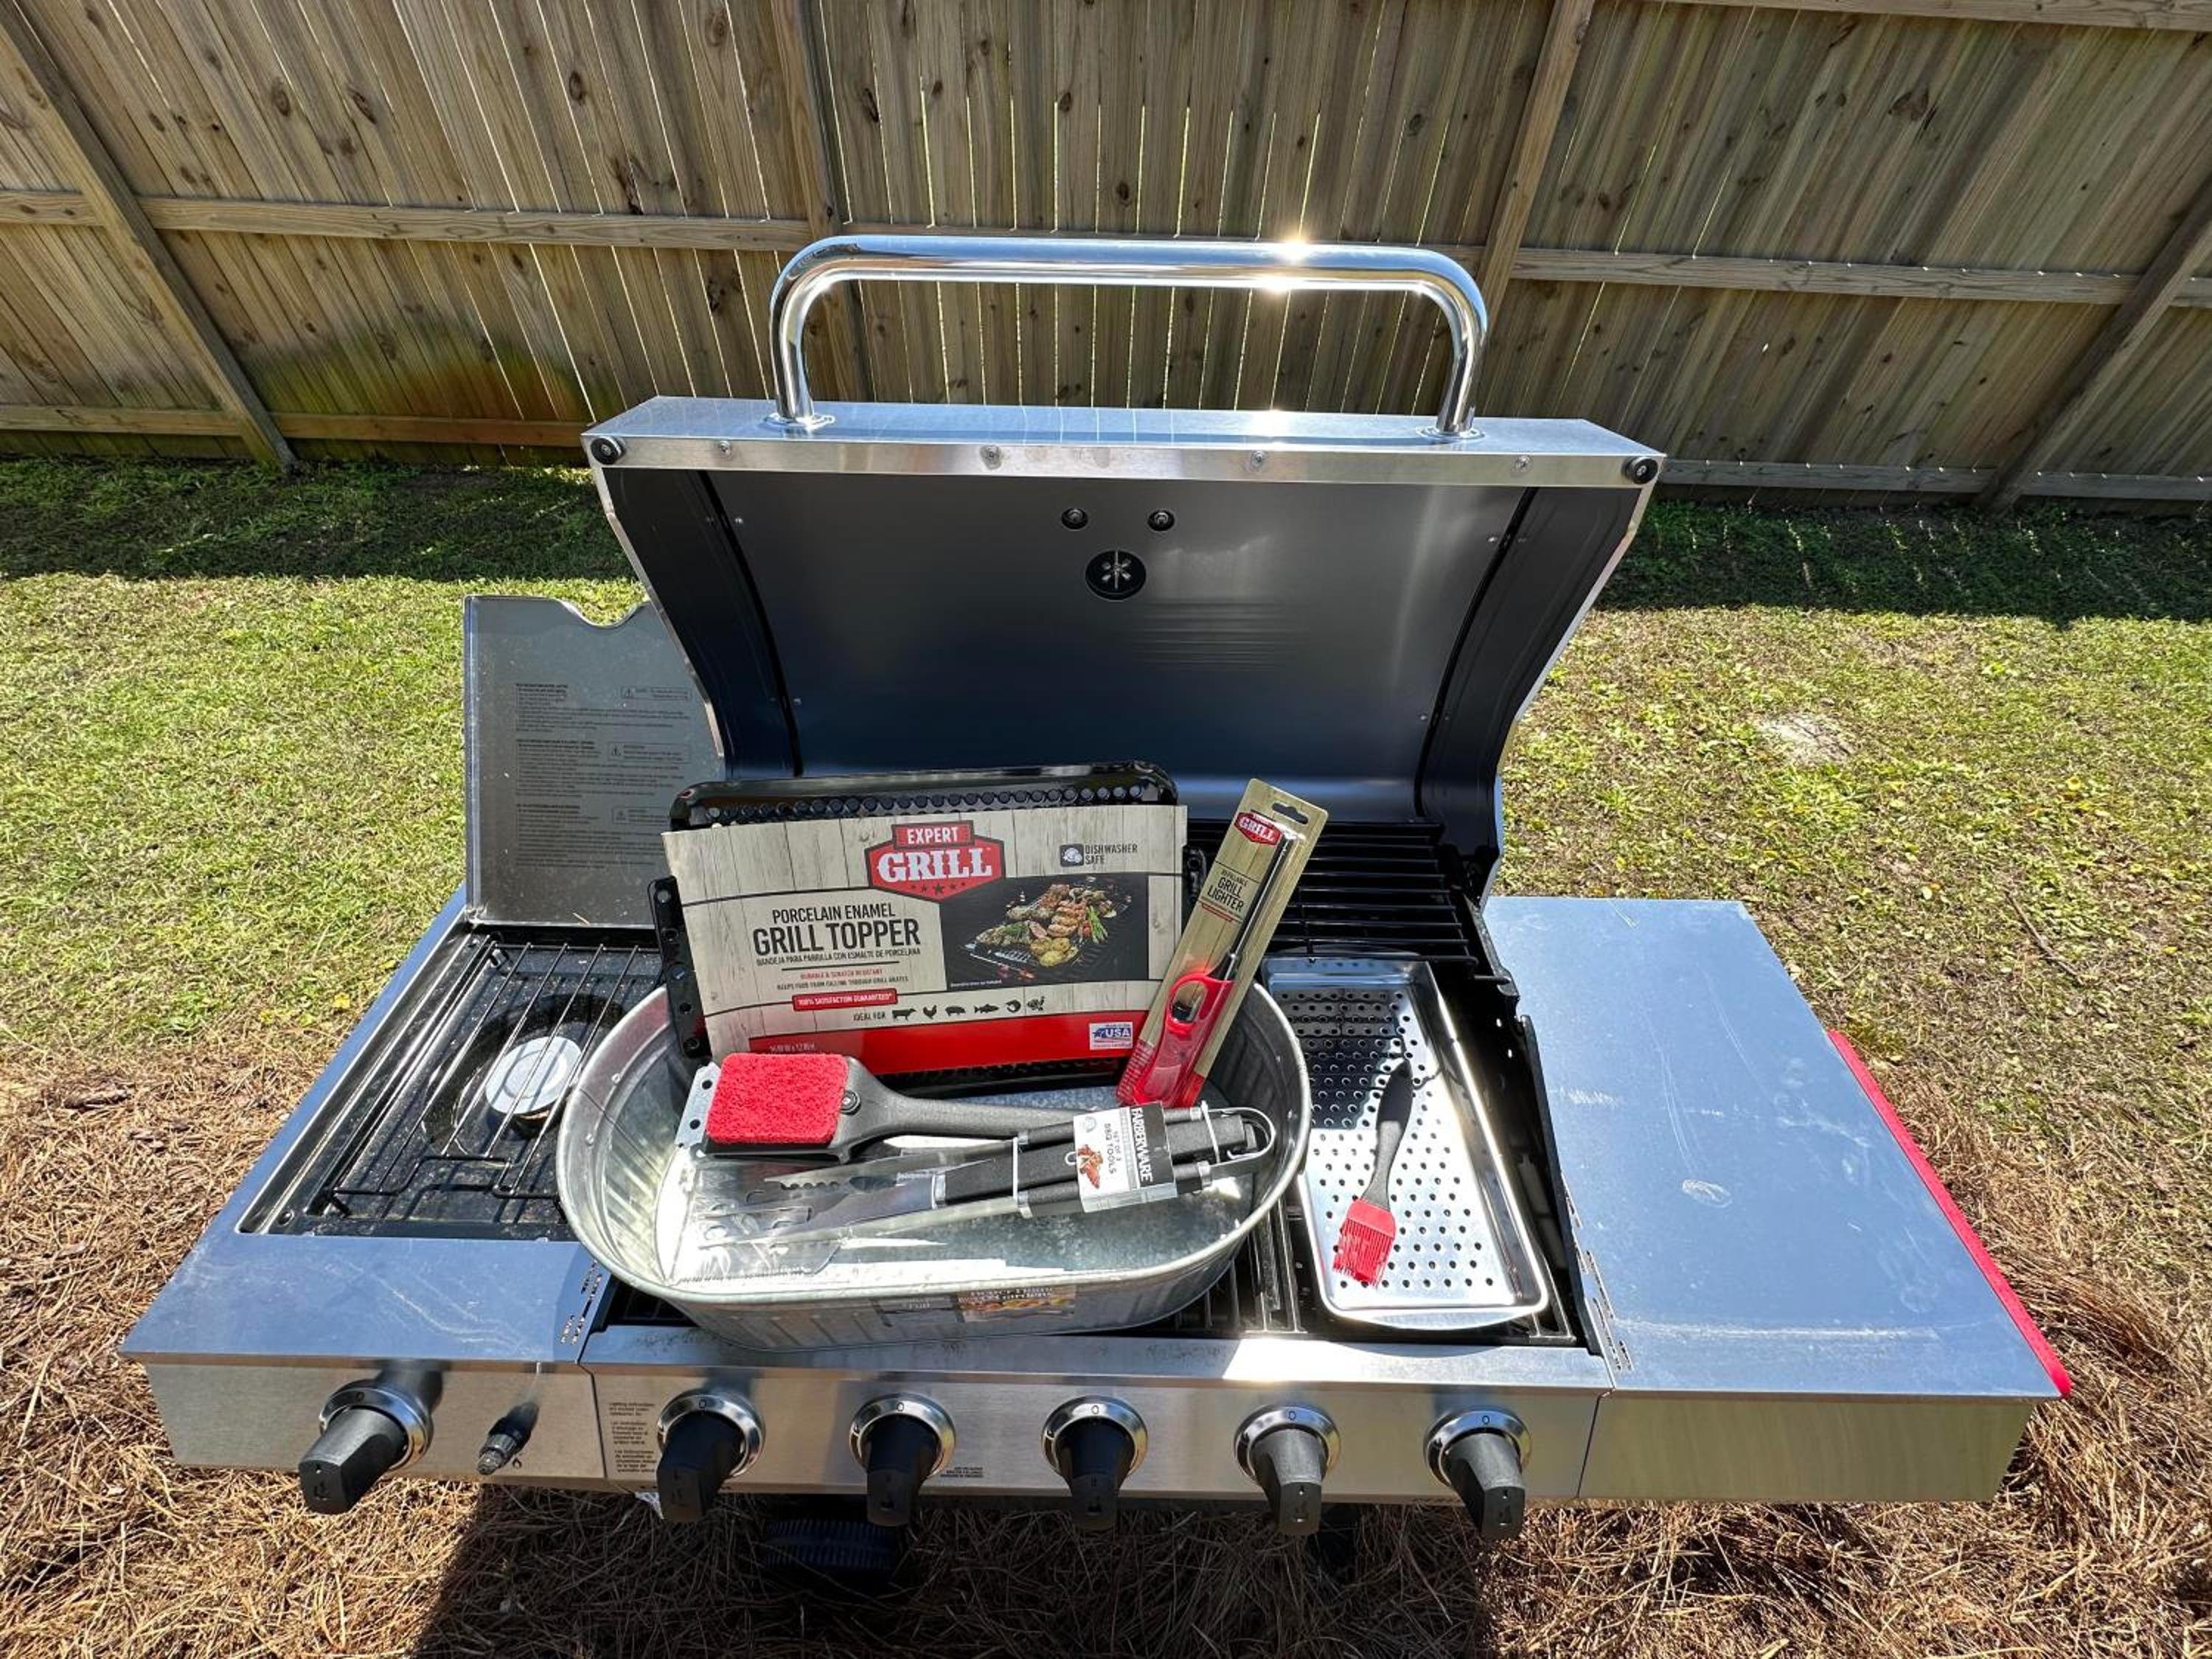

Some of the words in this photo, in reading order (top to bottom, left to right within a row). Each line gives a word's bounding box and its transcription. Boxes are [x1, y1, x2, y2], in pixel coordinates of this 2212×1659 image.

[907, 827, 958, 844] EXPERT
[1239, 816, 1275, 841] GRILL
[1085, 843, 1138, 855] DISHWASHER
[877, 848, 992, 883] GRILL
[1085, 855, 1105, 865] SAFE
[1218, 877, 1242, 898] GRILL
[1207, 885, 1244, 912] LIGHTER
[772, 905, 841, 925] PORCELAIN
[846, 902, 896, 919] ENAMEL
[753, 924, 824, 956] GRILL
[825, 918, 921, 950] TOPPER
[786, 954, 803, 963] PARA
[833, 951, 846, 960] CON
[847, 950, 874, 959] ESMALTE
[875, 949, 884, 958] DE
[885, 947, 921, 958] PORCELANA
[815, 995, 853, 1005] SATISFACTION
[853, 1012, 872, 1021] IDEAL
[873, 1011, 886, 1020] FOR
[1105, 1028, 1130, 1037] USA
[1104, 1123, 1113, 1141] BBQ
[1131, 1107, 1154, 1183] FARBERWARE
[1107, 1144, 1117, 1175] TOOLS
